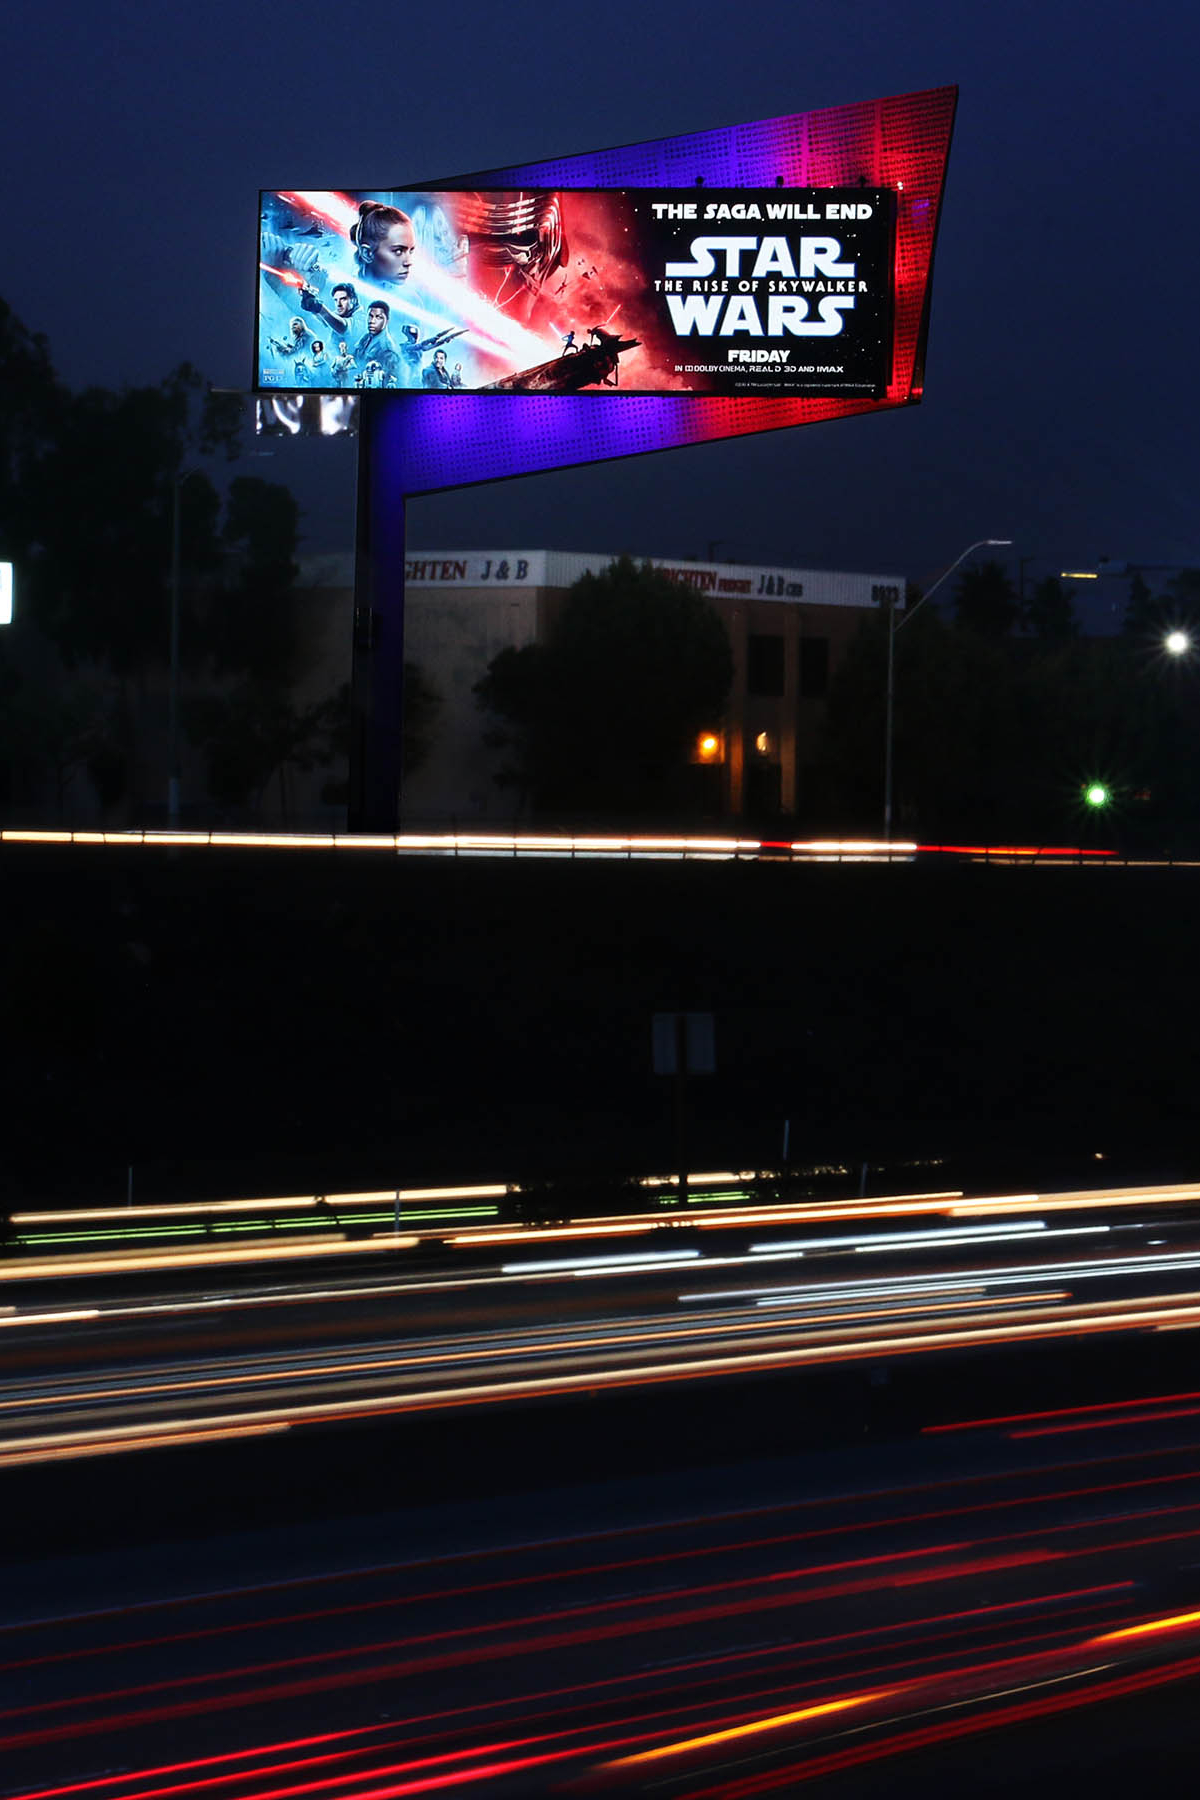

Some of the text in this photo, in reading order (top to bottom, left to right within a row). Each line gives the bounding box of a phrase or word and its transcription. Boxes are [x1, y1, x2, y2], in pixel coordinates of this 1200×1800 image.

[652, 203, 874, 220] THE SAGA WILL END
[665, 236, 856, 278] STAR
[654, 280, 869, 293] THE RISE OF SKYWALKER
[665, 294, 856, 337] WARS
[727, 349, 791, 363] FRIDAY
[674, 365, 683, 373] IN
[694, 365, 718, 373] DOLBY
[784, 365, 797, 373] 3D
[798, 365, 815, 373] AND
[816, 365, 844, 373] IMAX
[515, 560, 529, 580] B
